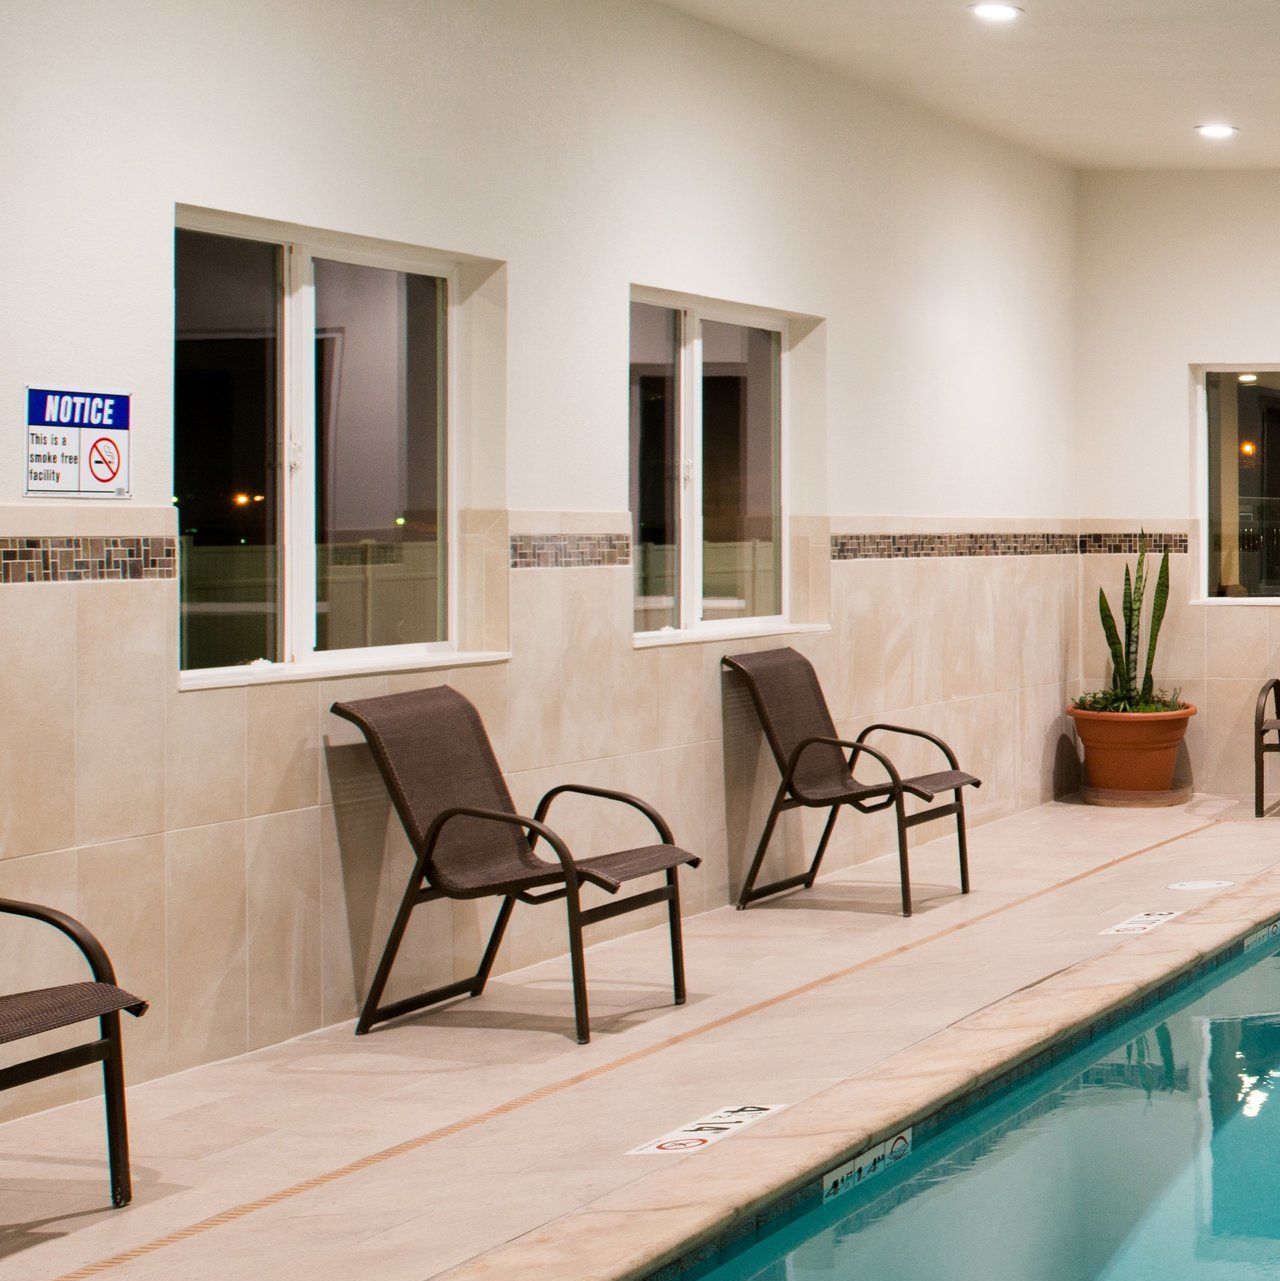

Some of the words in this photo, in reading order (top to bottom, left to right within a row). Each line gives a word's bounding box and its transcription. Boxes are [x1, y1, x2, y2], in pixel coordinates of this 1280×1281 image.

[44, 394, 115, 425] NOTICE
[29, 432, 48, 446] This
[51, 433, 59, 446] is
[62, 436, 67, 446] a
[29, 451, 58, 464] smoke
[61, 452, 79, 464] free
[29, 468, 61, 484] facility
